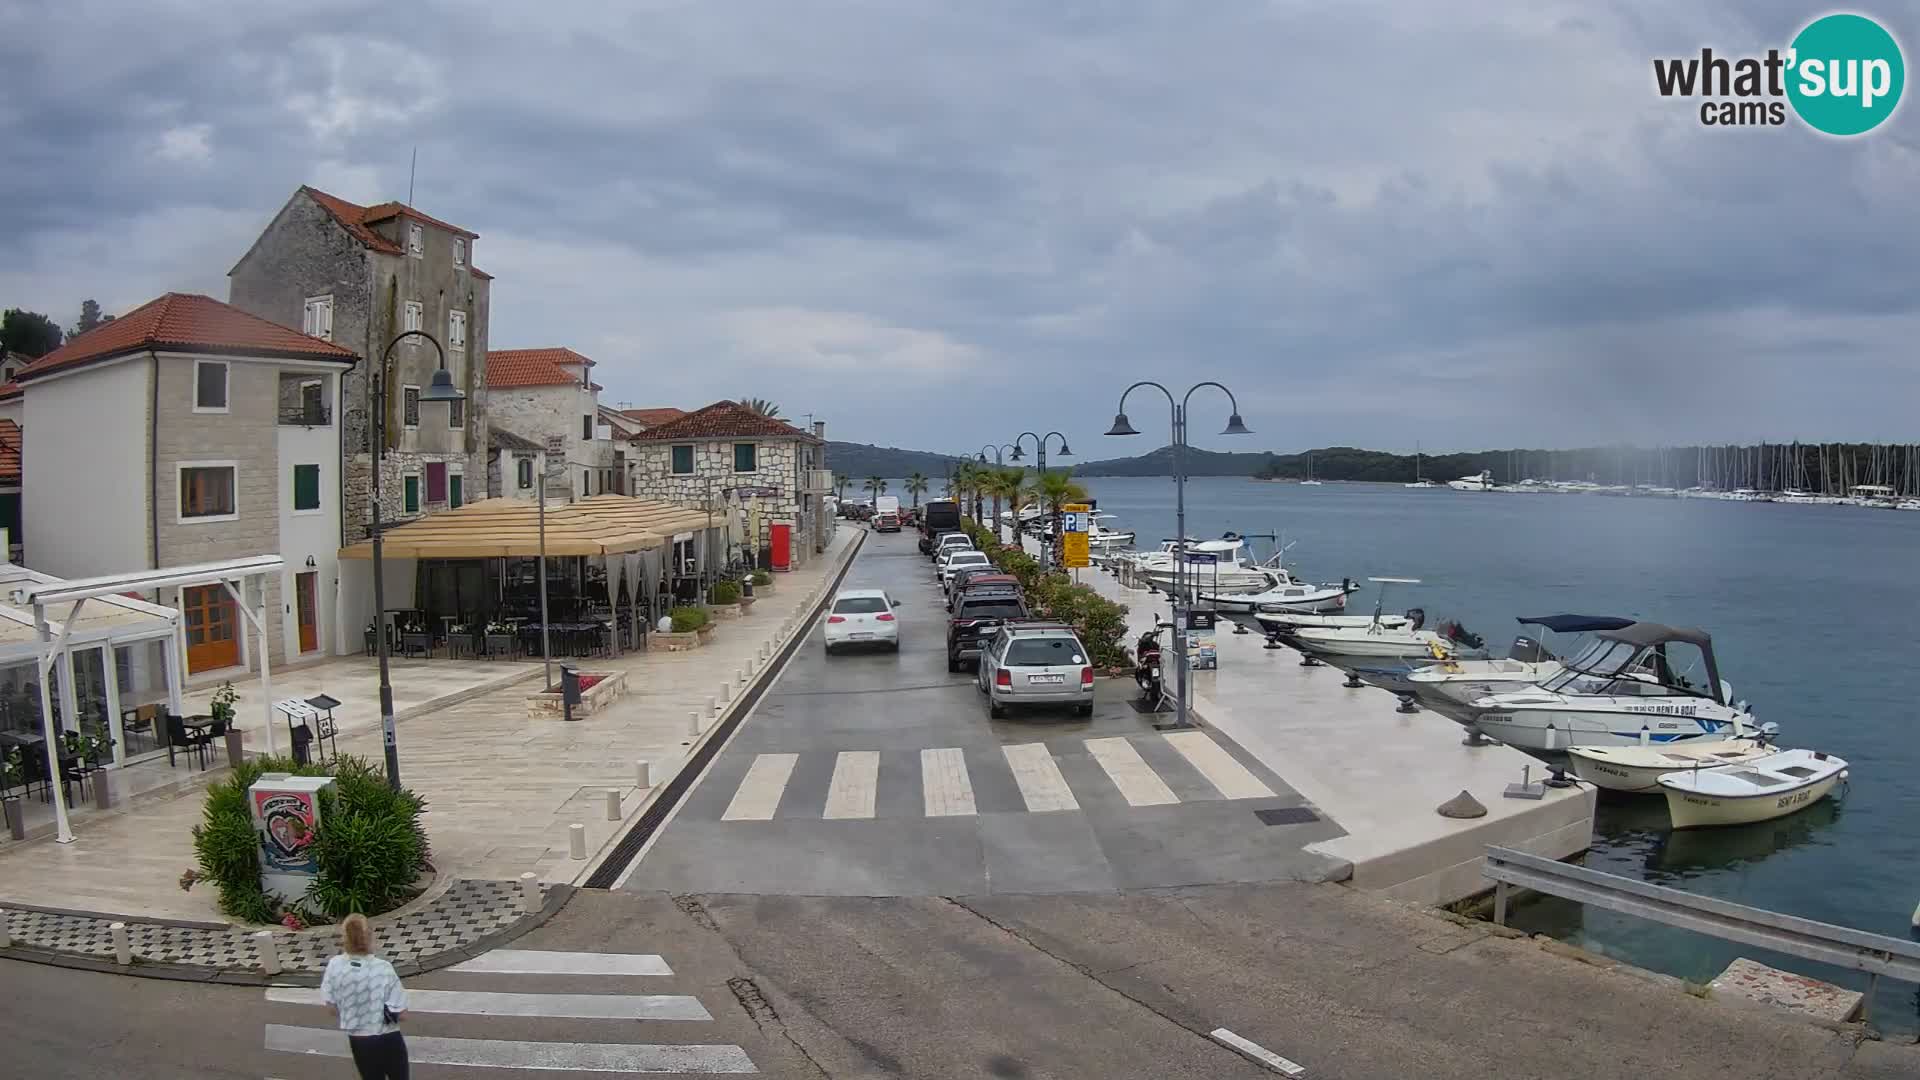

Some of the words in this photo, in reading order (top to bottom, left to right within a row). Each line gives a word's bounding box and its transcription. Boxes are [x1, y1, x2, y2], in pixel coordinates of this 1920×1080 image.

[1065, 514, 1075, 530] P
[1656, 705, 1674, 714] RENT
[1675, 705, 1679, 714] A
[1680, 705, 1697, 716] BOAT
[1777, 795, 1793, 808] RENT
[1797, 790, 1811, 804] BOAT
